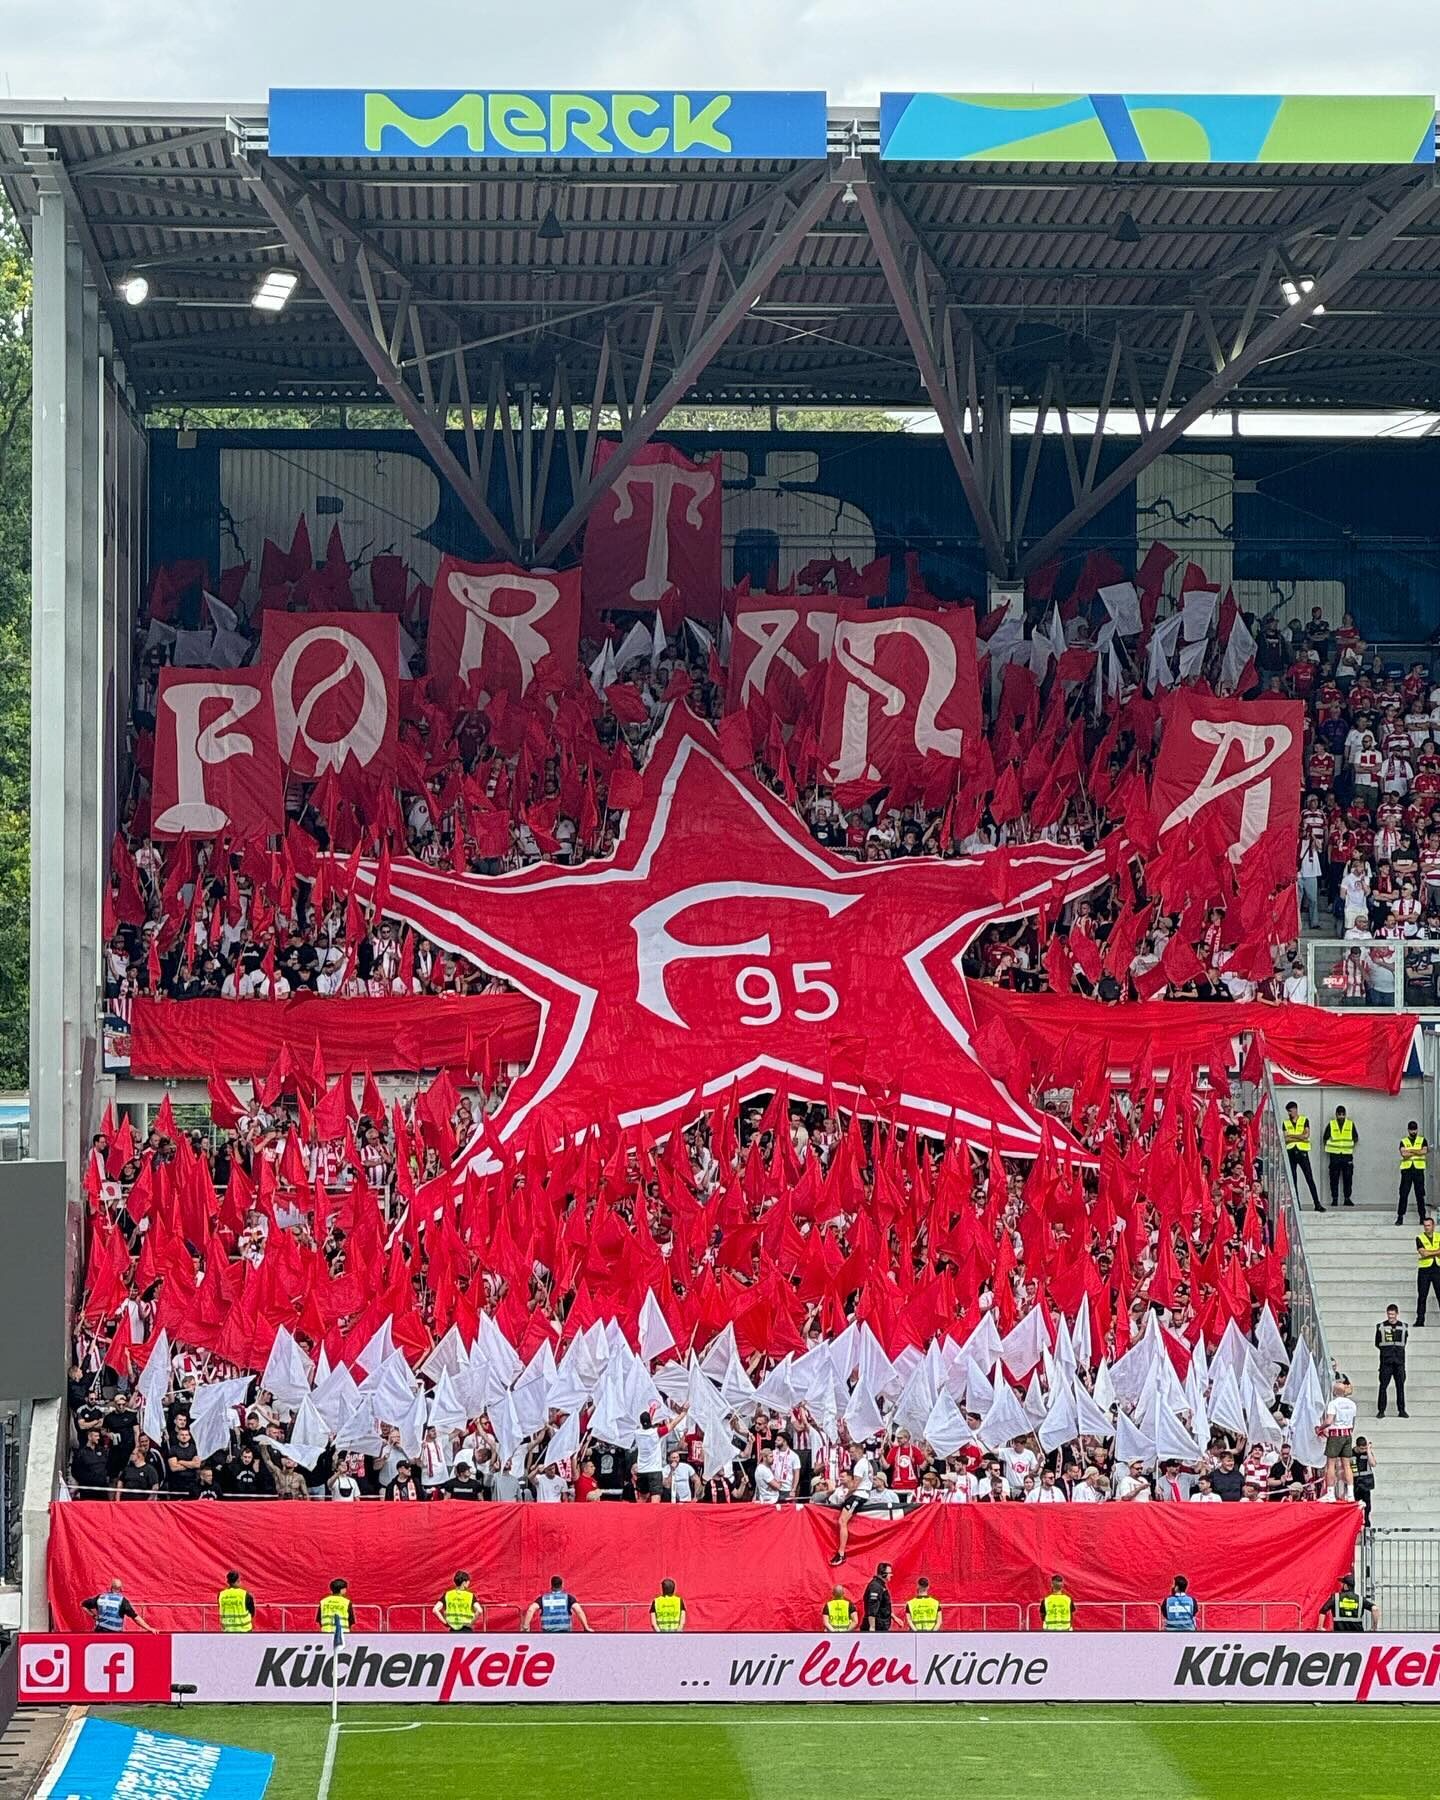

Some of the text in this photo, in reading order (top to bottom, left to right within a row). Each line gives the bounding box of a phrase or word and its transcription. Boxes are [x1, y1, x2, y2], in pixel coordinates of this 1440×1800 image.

[155, 683, 261, 833] F
[606, 462, 716, 602] T
[735, 961, 840, 1026] 95
[729, 1652, 795, 1687] wir
[799, 1640, 918, 1688] leben
[923, 1652, 1048, 1686] Küche
